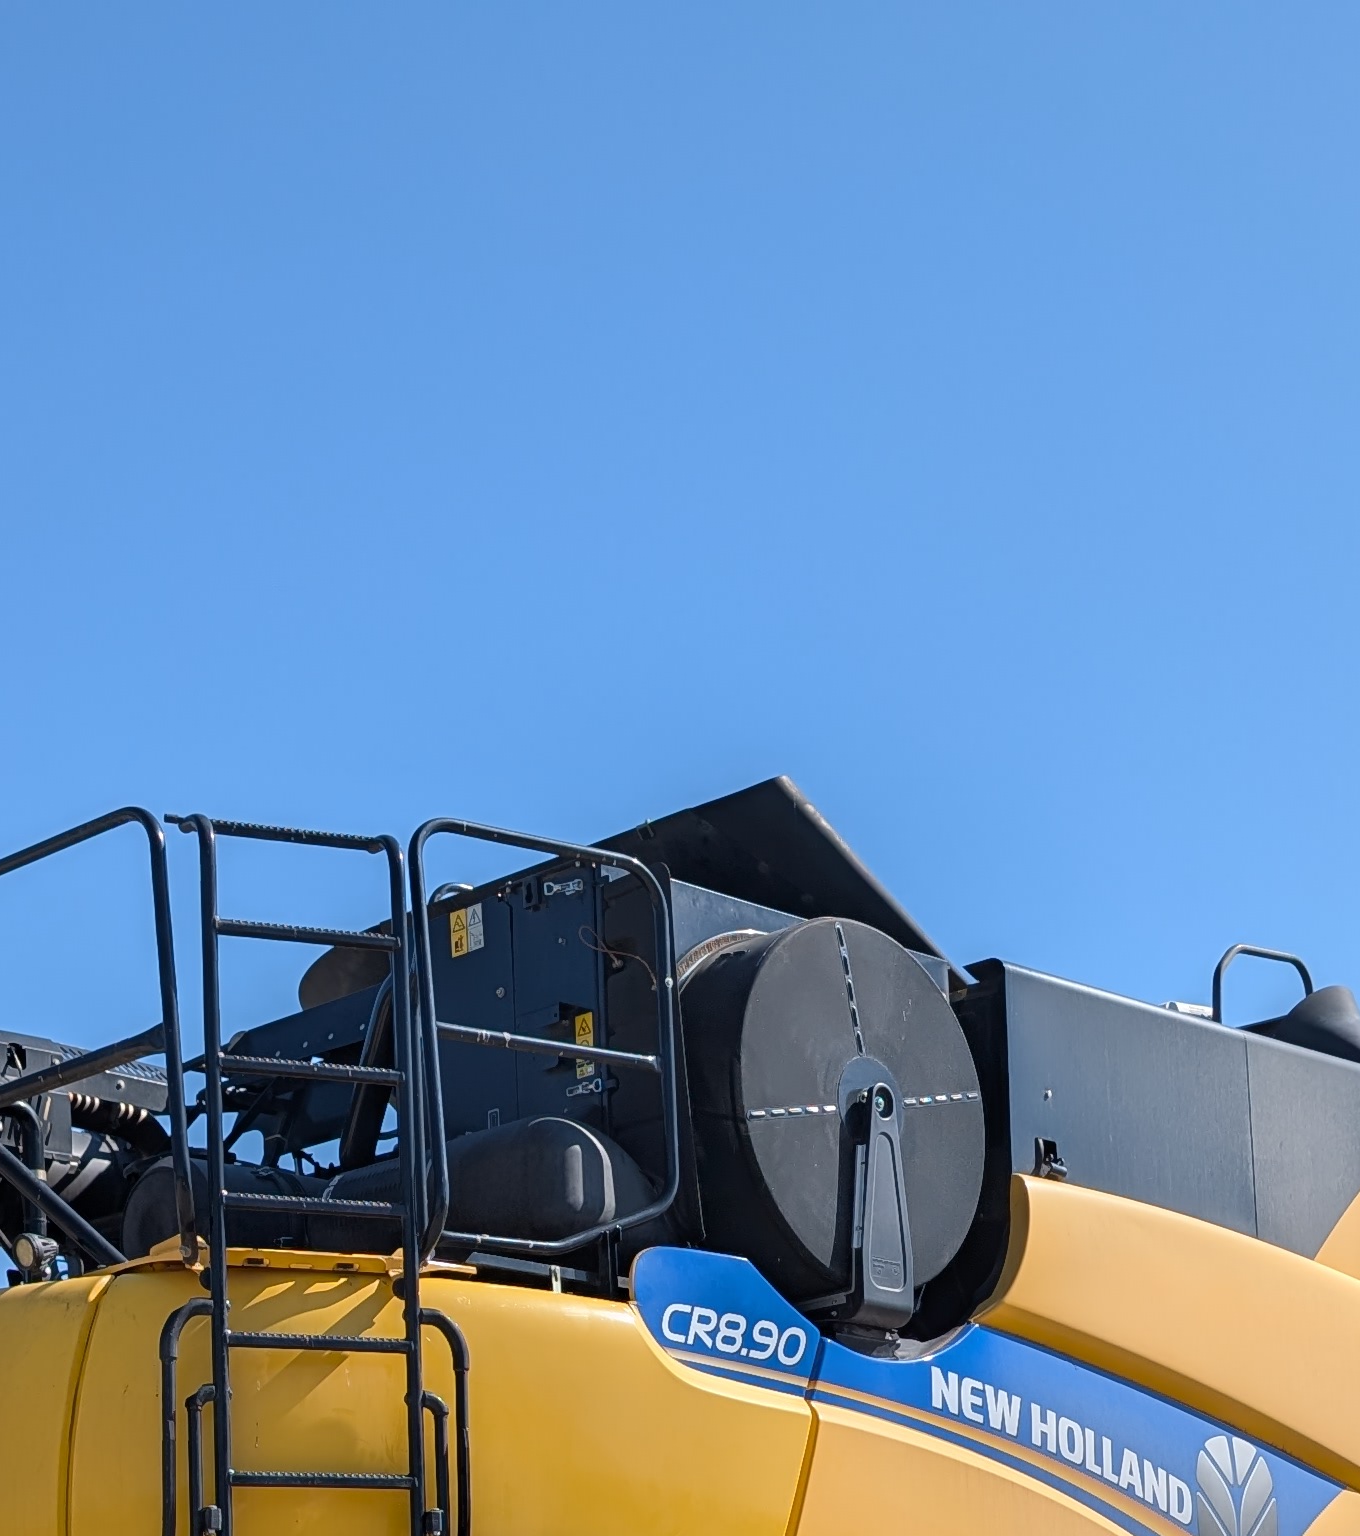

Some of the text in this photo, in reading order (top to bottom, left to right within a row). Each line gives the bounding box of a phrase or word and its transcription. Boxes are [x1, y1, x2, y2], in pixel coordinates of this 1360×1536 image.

[661, 1303, 808, 1367] CR8.90
[930, 1365, 1194, 1526] NEW HOLLAND
